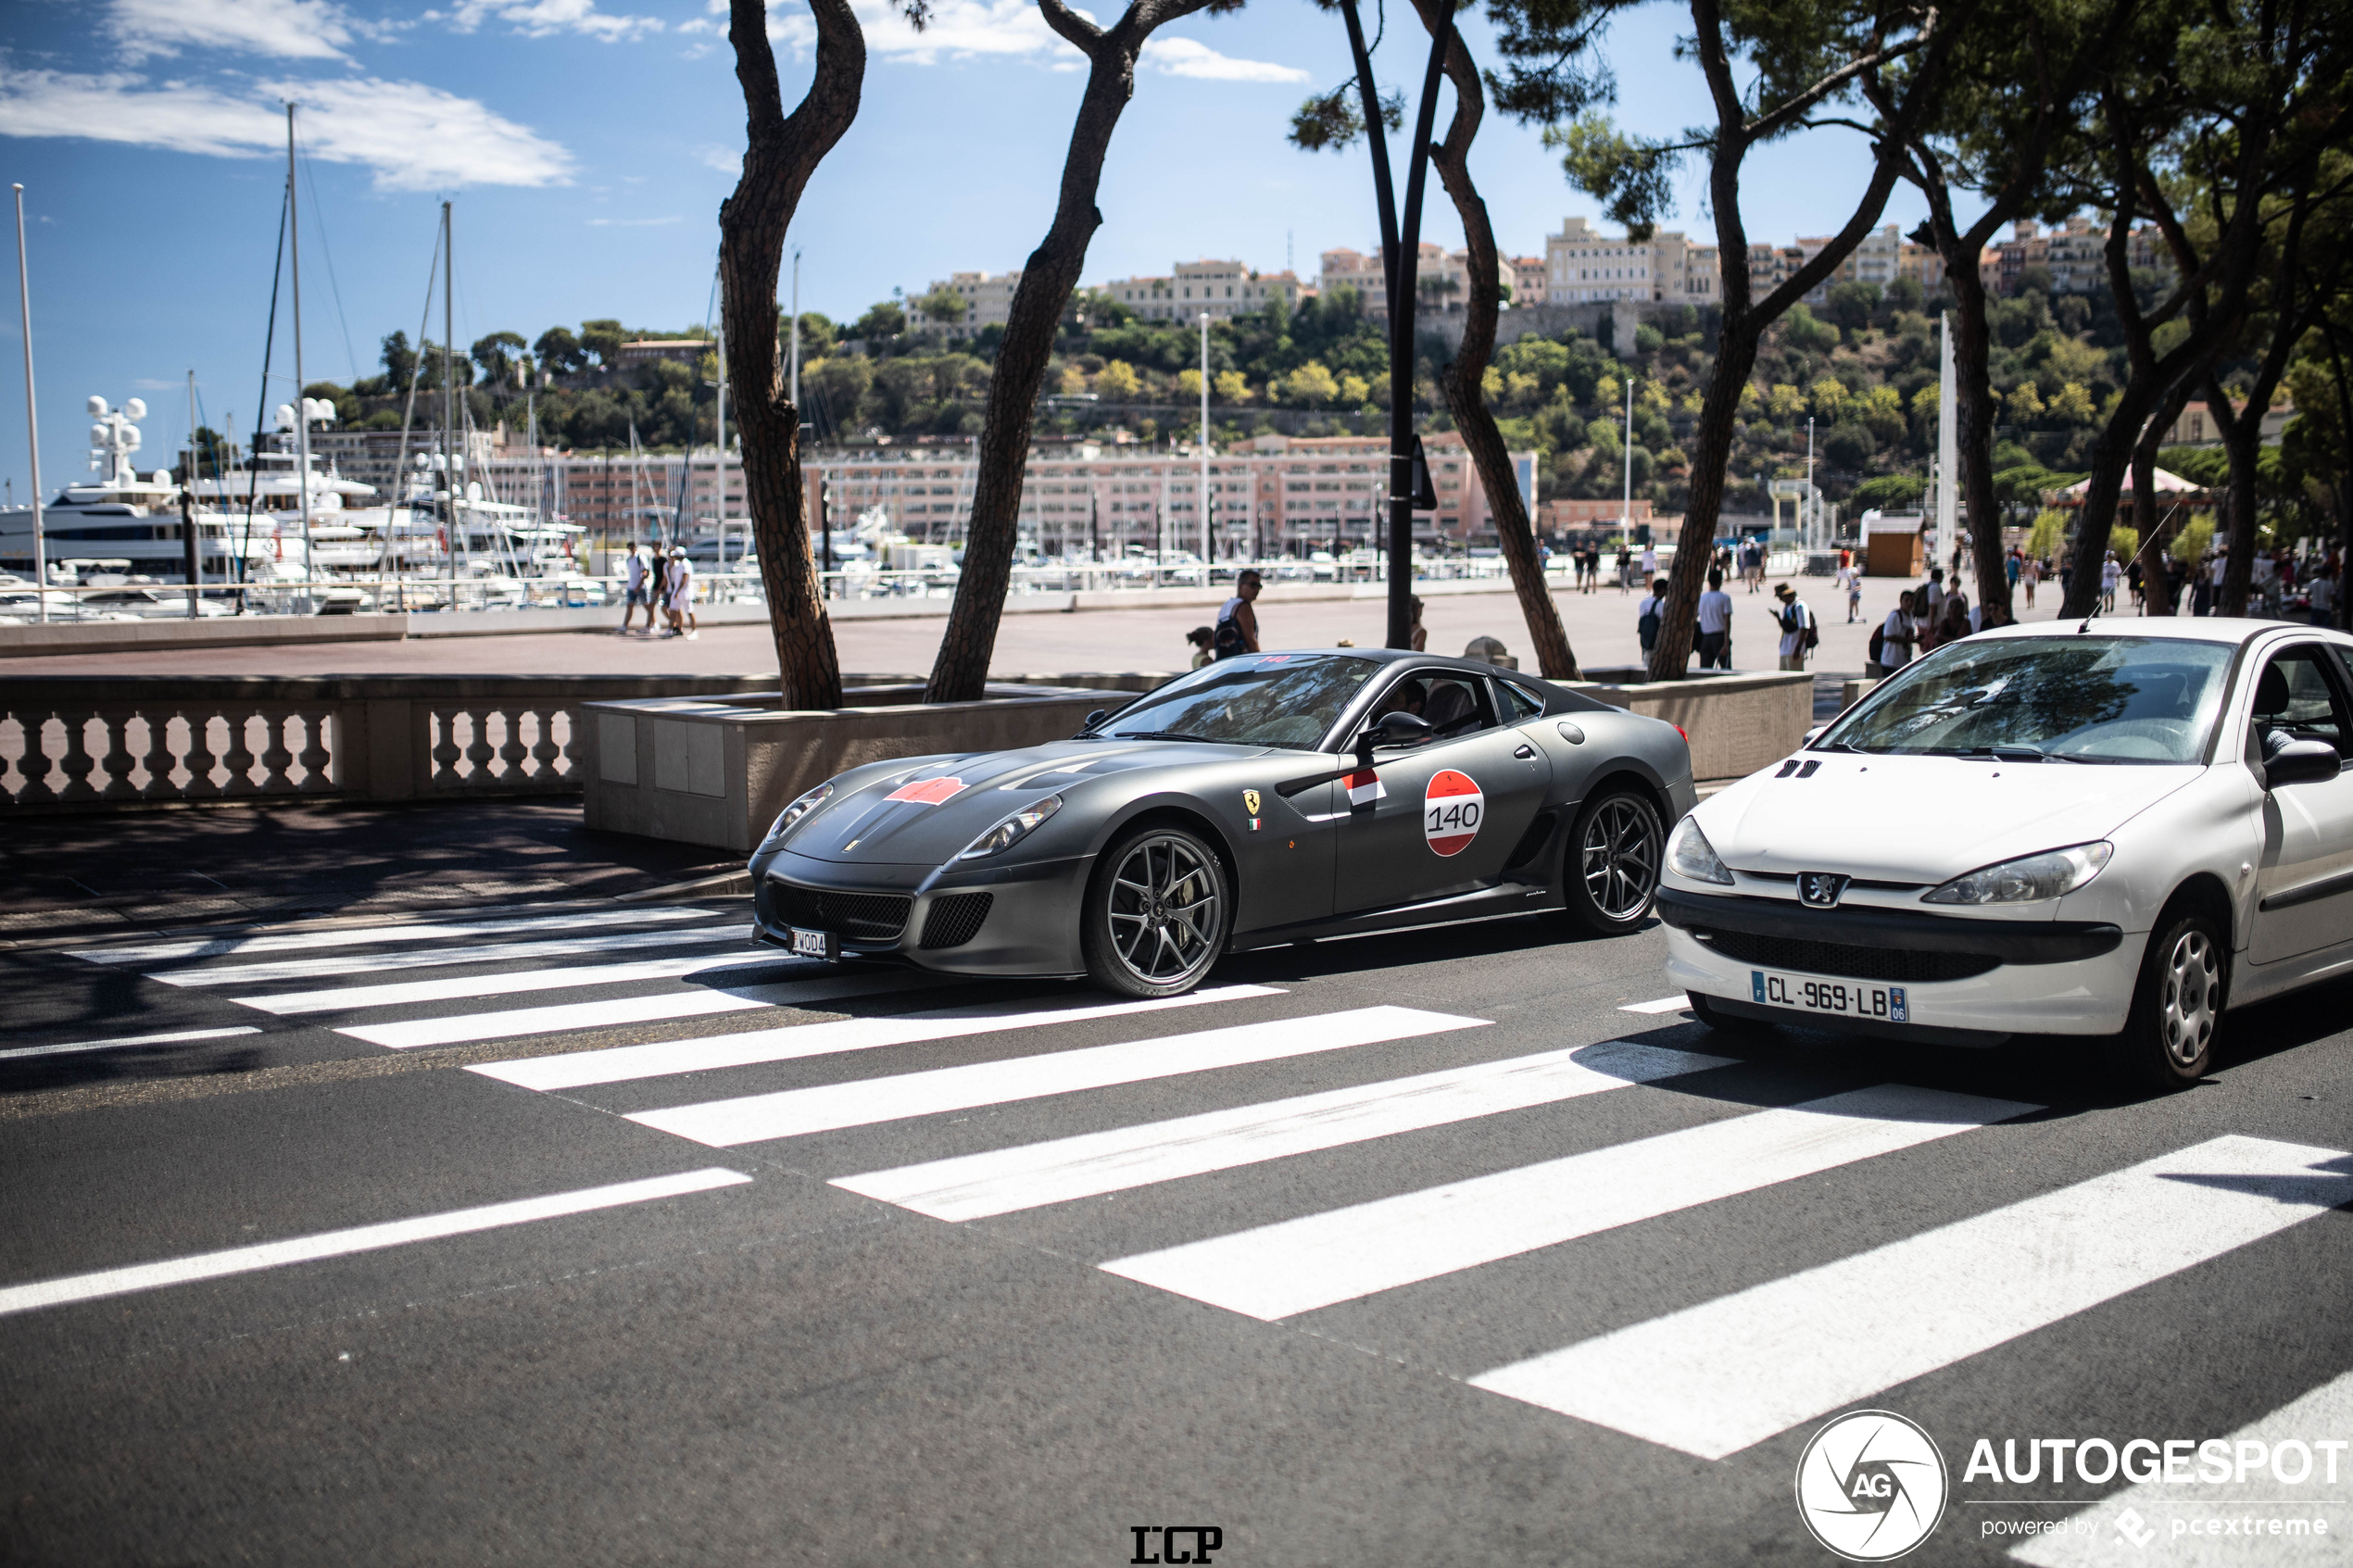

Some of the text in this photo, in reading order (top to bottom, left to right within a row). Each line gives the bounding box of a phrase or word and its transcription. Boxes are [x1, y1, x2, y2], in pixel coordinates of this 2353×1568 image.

[1428, 802, 1479, 833] 140
[1768, 976, 1888, 1017] CL-969-LB
[1892, 1007, 1905, 1021] 06
